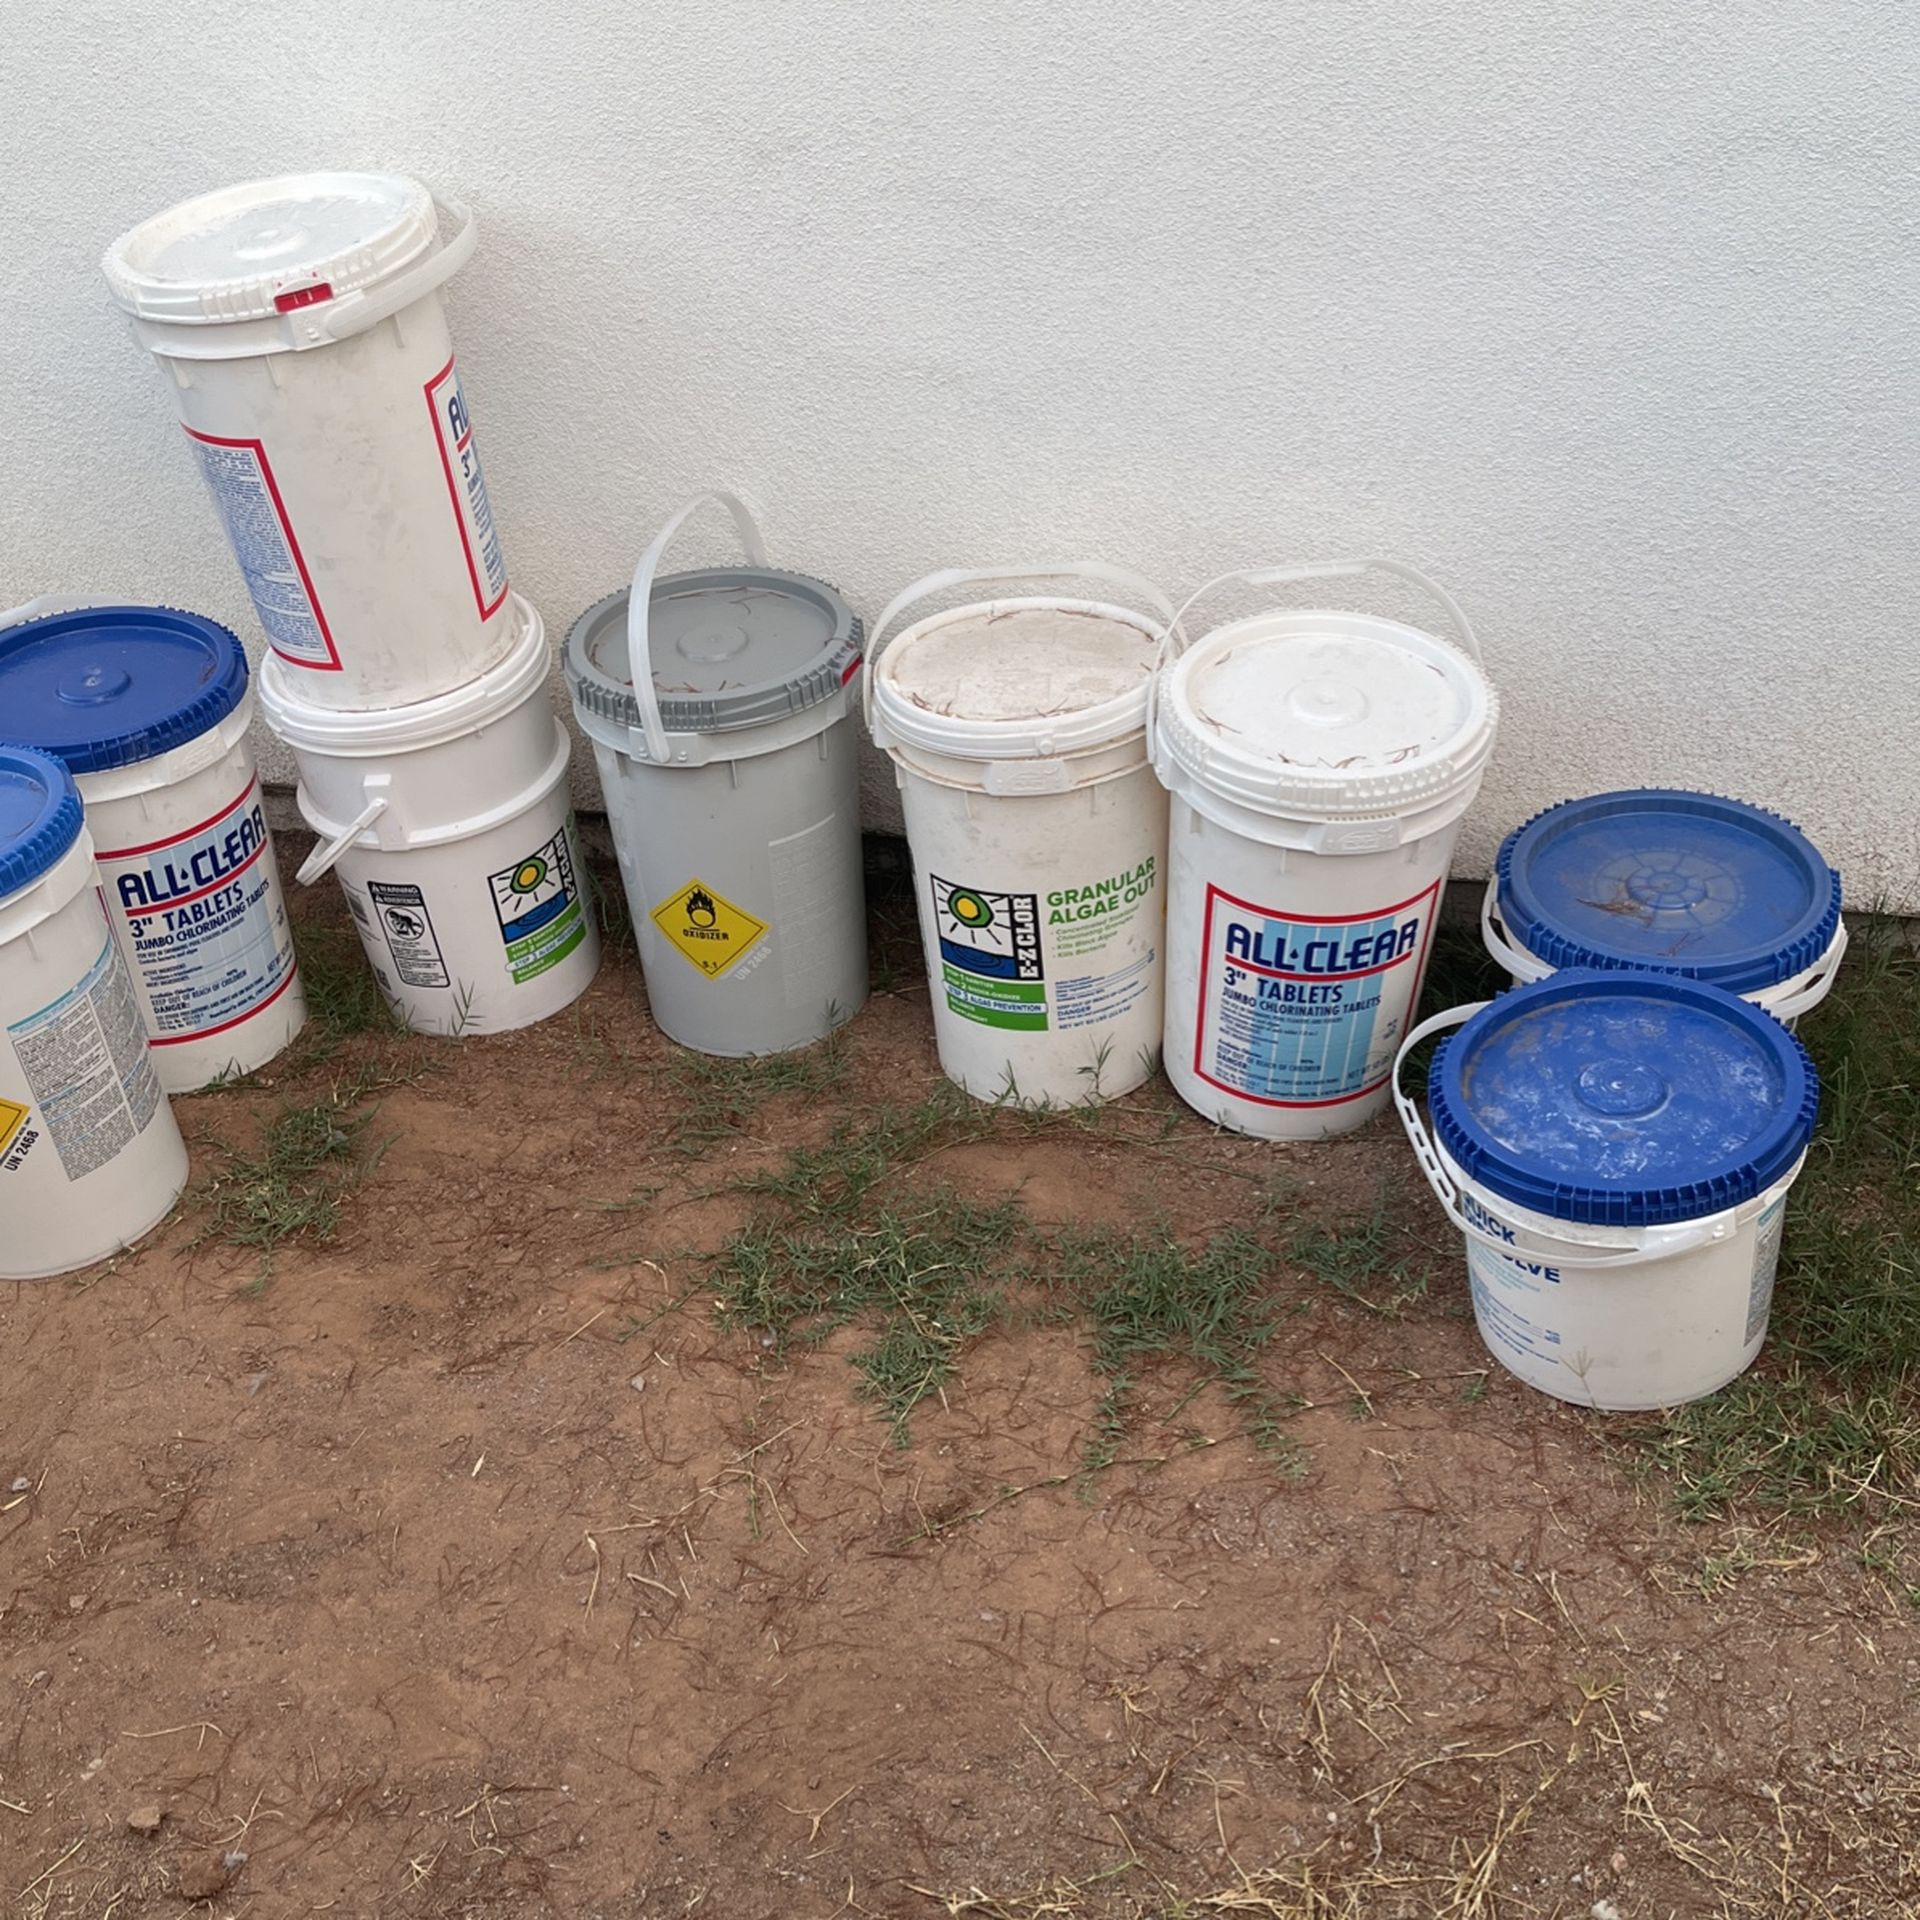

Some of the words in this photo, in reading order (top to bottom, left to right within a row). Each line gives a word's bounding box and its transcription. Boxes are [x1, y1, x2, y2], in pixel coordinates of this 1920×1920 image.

[117, 864, 191, 907] ALL
[190, 804, 265, 887] CLEAR
[1047, 856, 1155, 907] GRANULAR
[1048, 895, 1119, 925] ALGAE
[1124, 871, 1157, 903] OUT
[129, 917, 153, 938] 3"
[162, 881, 243, 931] TABLETS
[135, 934, 174, 951] JUMBO
[176, 901, 246, 942] CHLORINATING
[246, 878, 270, 910] TABLETS
[1013, 897, 1036, 946] CLOR
[683, 929, 729, 941] OXIDIZER
[1226, 923, 1296, 971] ALL
[1303, 918, 1419, 973] CLEAR
[734, 966, 752, 980] UN
[748, 946, 772, 968] 2468
[1017, 948, 1039, 979] E-Z
[1223, 966, 1247, 986] 3"
[1257, 977, 1344, 1004] TABLETS
[993, 1000, 1041, 1012] PREVENTION
[1222, 986, 1256, 1007] JUMBO
[1259, 999, 1340, 1017] CHLORINATING
[1343, 994, 1381, 1013] TABLETS
[4, 1155, 23, 1171] UN
[15, 1130, 39, 1156] 2468
